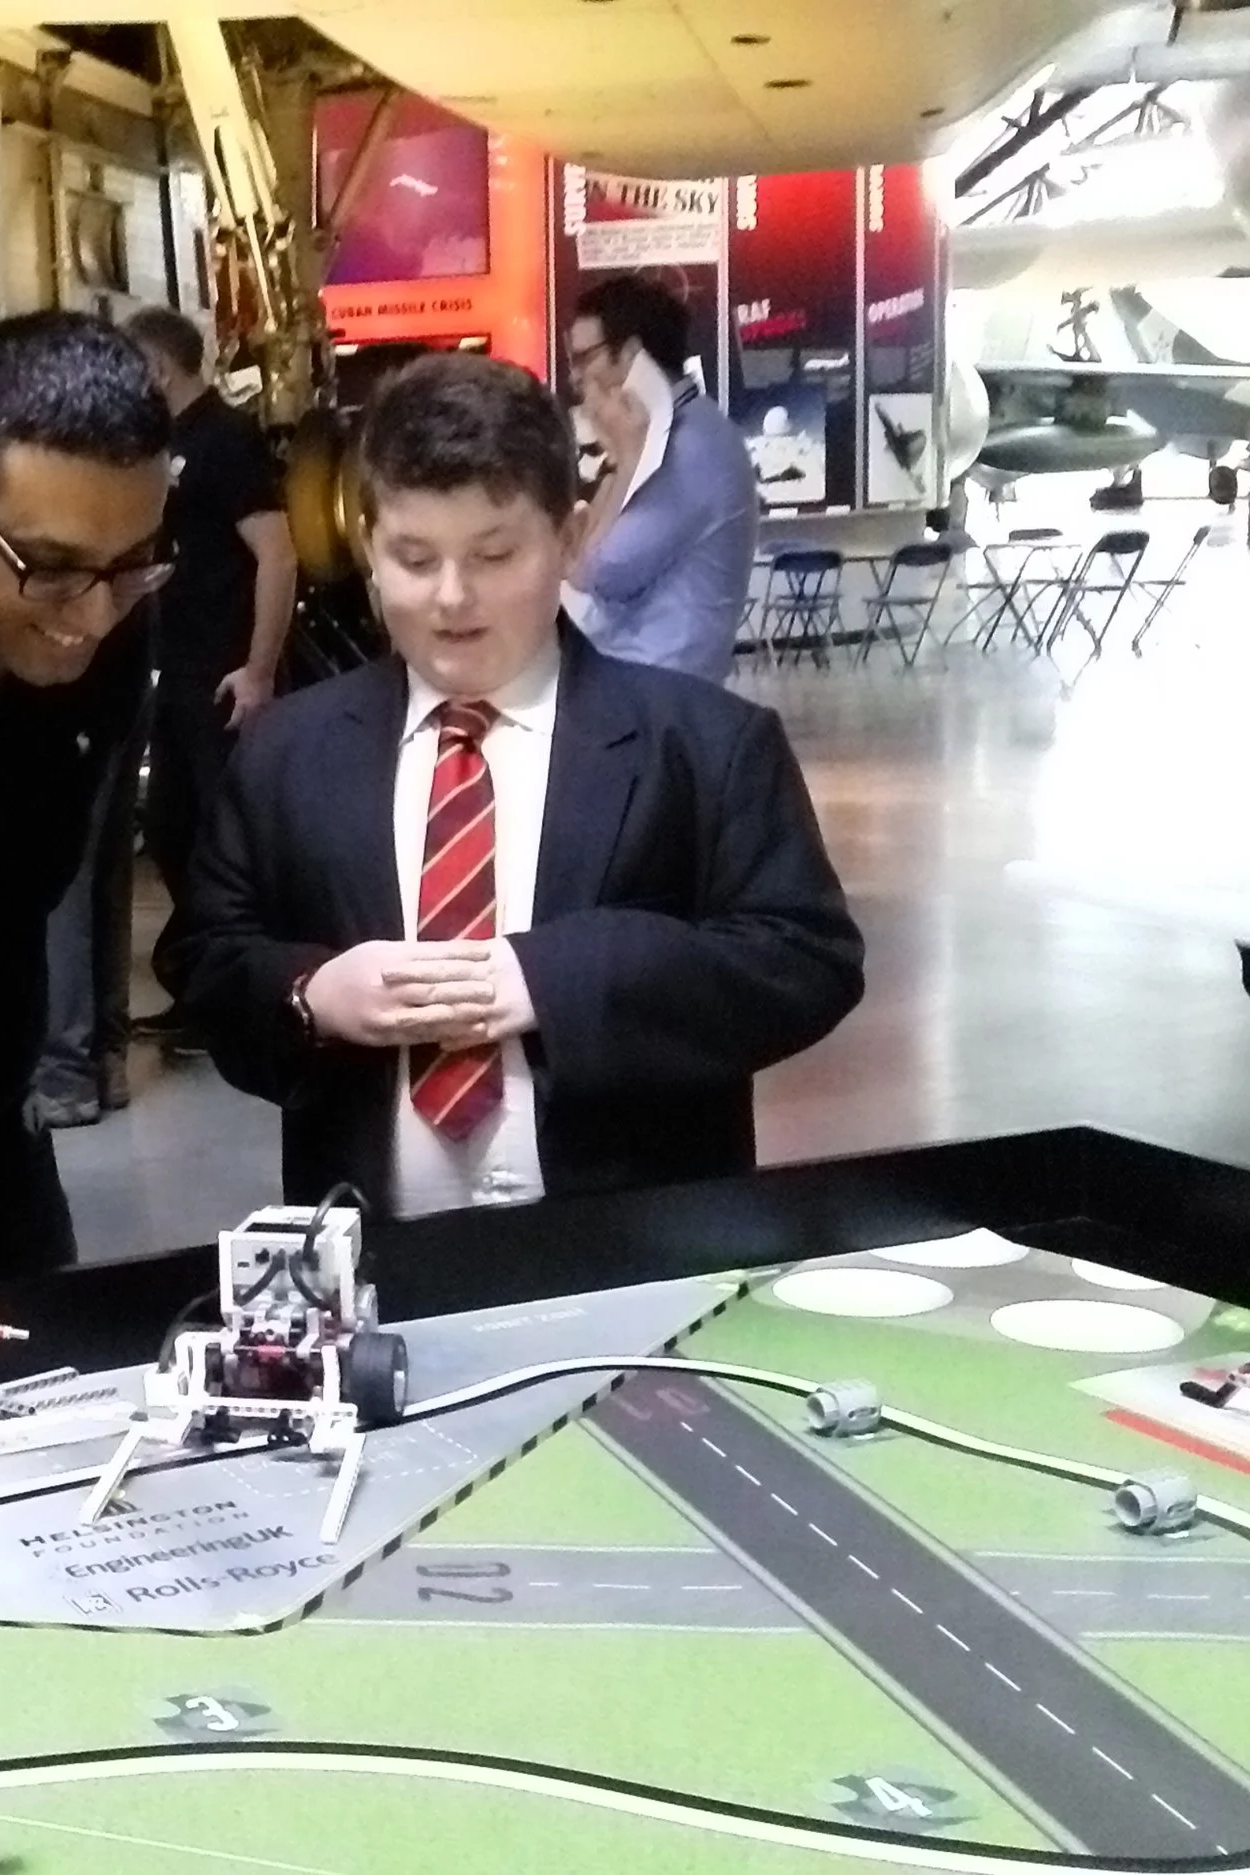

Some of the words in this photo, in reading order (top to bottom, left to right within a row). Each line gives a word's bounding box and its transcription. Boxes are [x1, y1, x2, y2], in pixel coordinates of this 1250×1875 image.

[674, 187, 719, 214] SKY
[378, 302, 426, 316] MISSILE
[431, 298, 473, 312] CRISIS
[64, 1524, 295, 1579] EngineeringUK
[126, 1552, 341, 1603] Rolls-Royce
[185, 1696, 239, 1732] 3
[865, 1775, 933, 1817] 4
